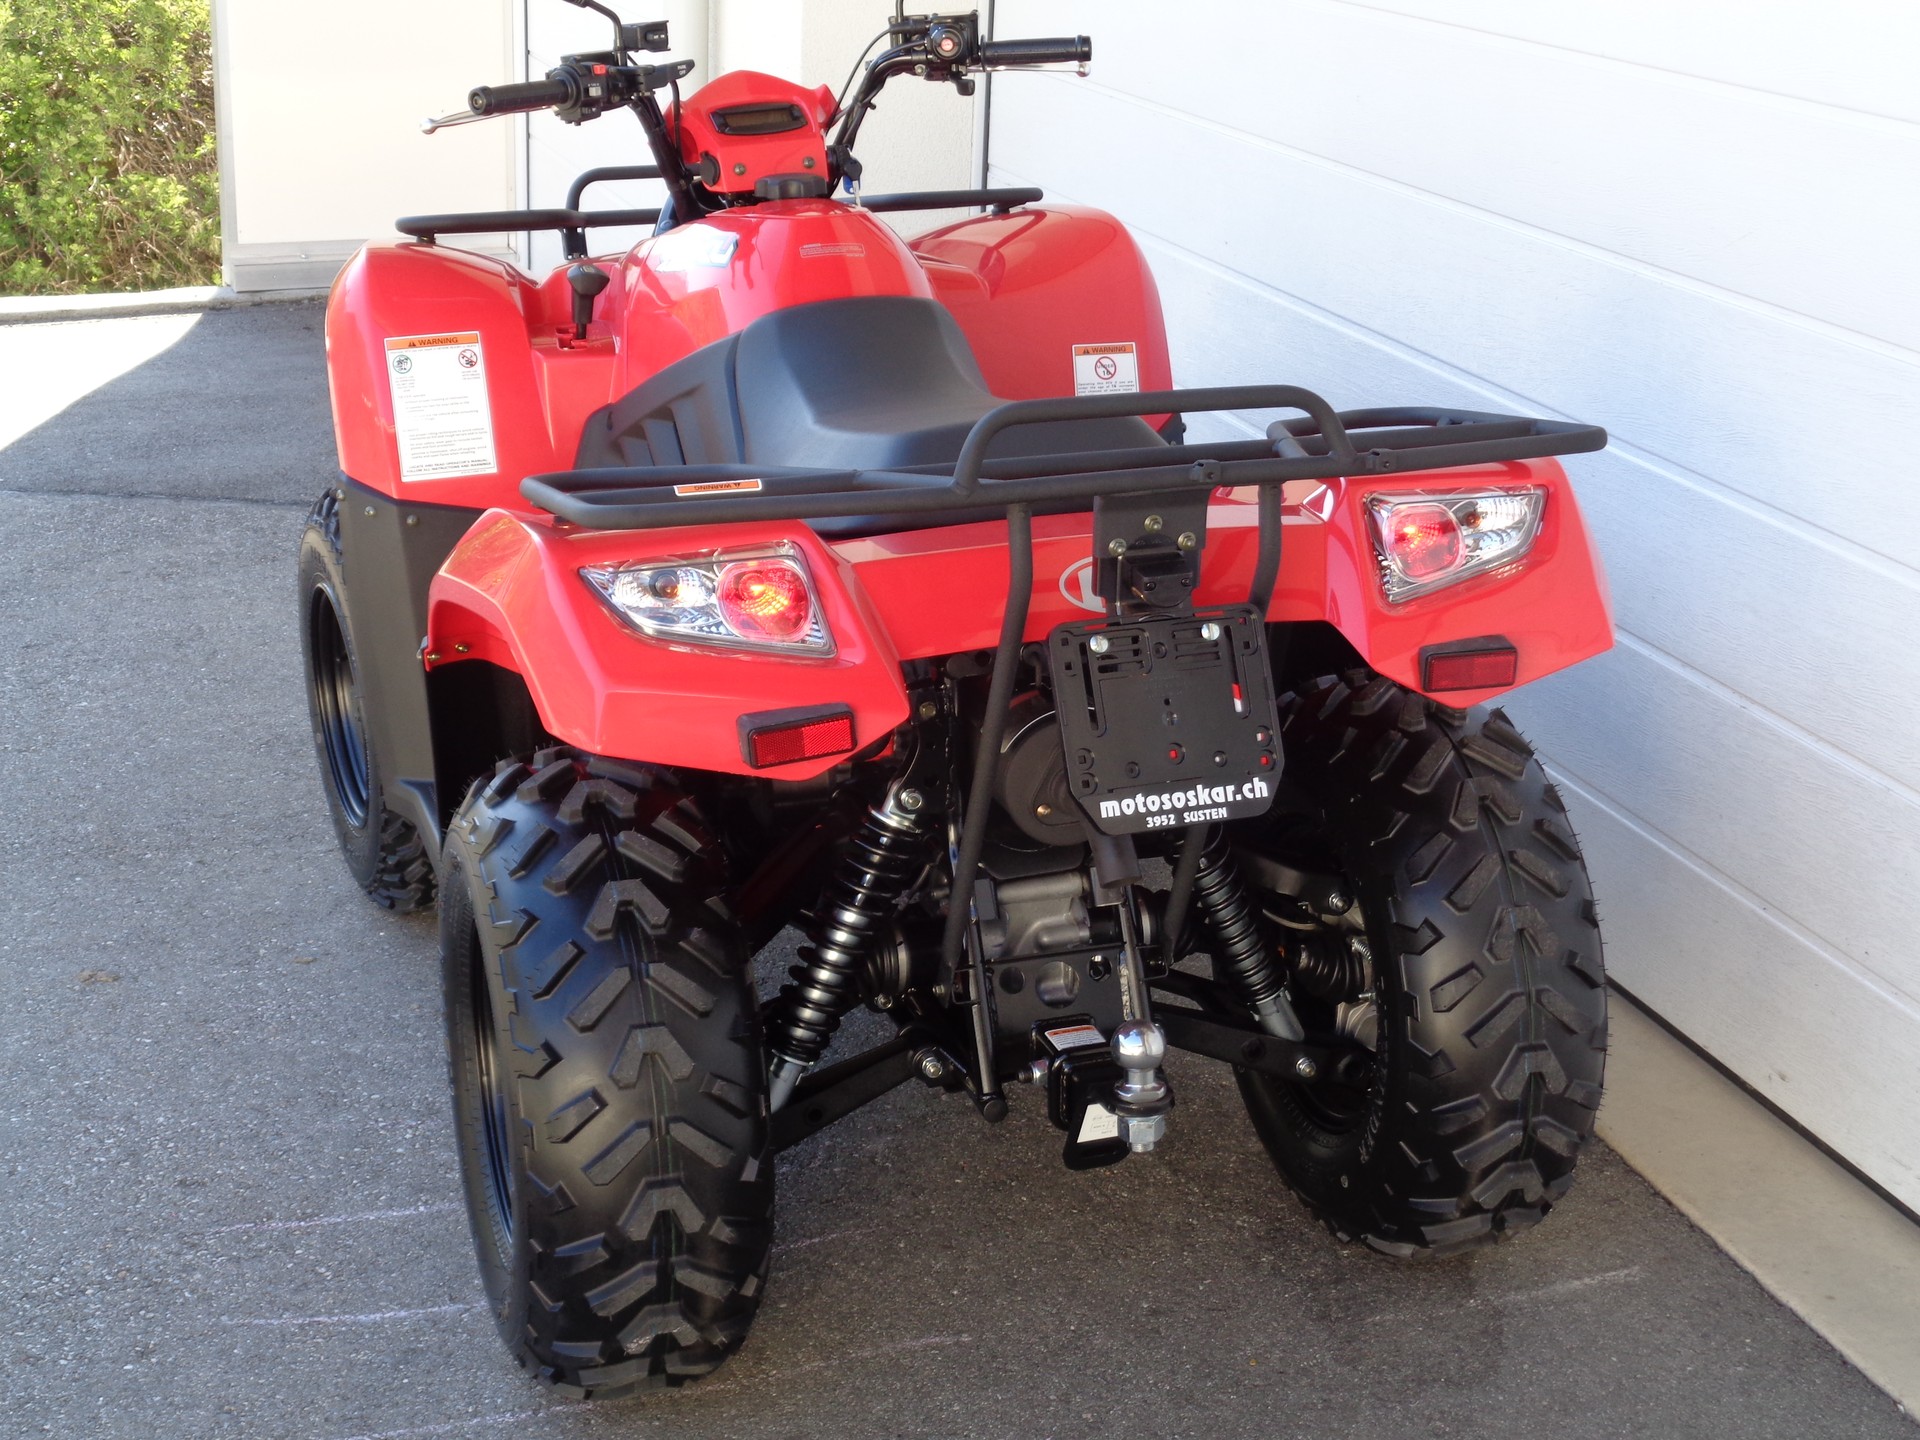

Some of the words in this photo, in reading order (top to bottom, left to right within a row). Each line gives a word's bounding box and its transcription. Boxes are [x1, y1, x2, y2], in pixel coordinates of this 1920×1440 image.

[418, 337, 458, 346] WARNING
[694, 483, 732, 491] WARNING
[1099, 777, 1269, 819] motososkar.ch
[1145, 814, 1176, 828] 3952
[1183, 807, 1228, 823] SUSTEN
